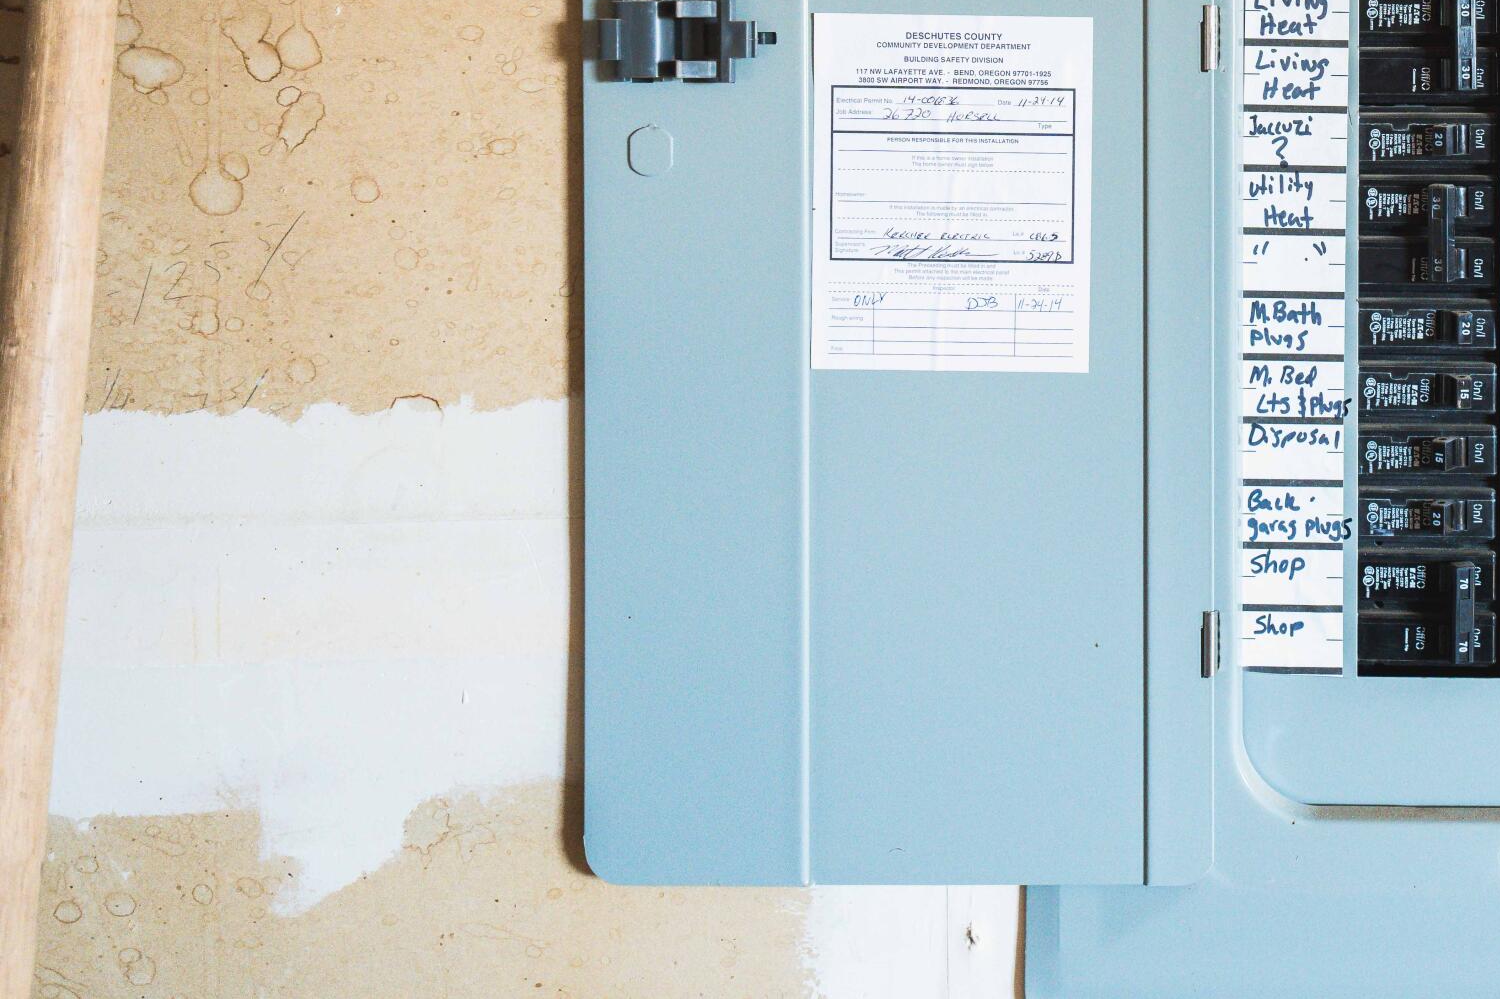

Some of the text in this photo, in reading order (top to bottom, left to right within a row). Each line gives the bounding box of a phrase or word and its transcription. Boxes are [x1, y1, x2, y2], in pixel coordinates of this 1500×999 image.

[1461, 2, 1470, 17] 30
[1260, 12, 1318, 36] Heat
[905, 31, 962, 41] DESCHUTES
[923, 42, 979, 50] DEVELOPMENT
[1255, 48, 1330, 81] Living
[1461, 65, 1470, 80] 30
[1262, 77, 1320, 101] Heat
[1434, 132, 1443, 147] 20
[1264, 205, 1314, 229] Heat
[1461, 321, 1470, 336] 20
[1460, 389, 1469, 400] 15
[1432, 512, 1441, 526] 20
[1459, 578, 1468, 590] 70
[1459, 641, 1468, 652] 70
